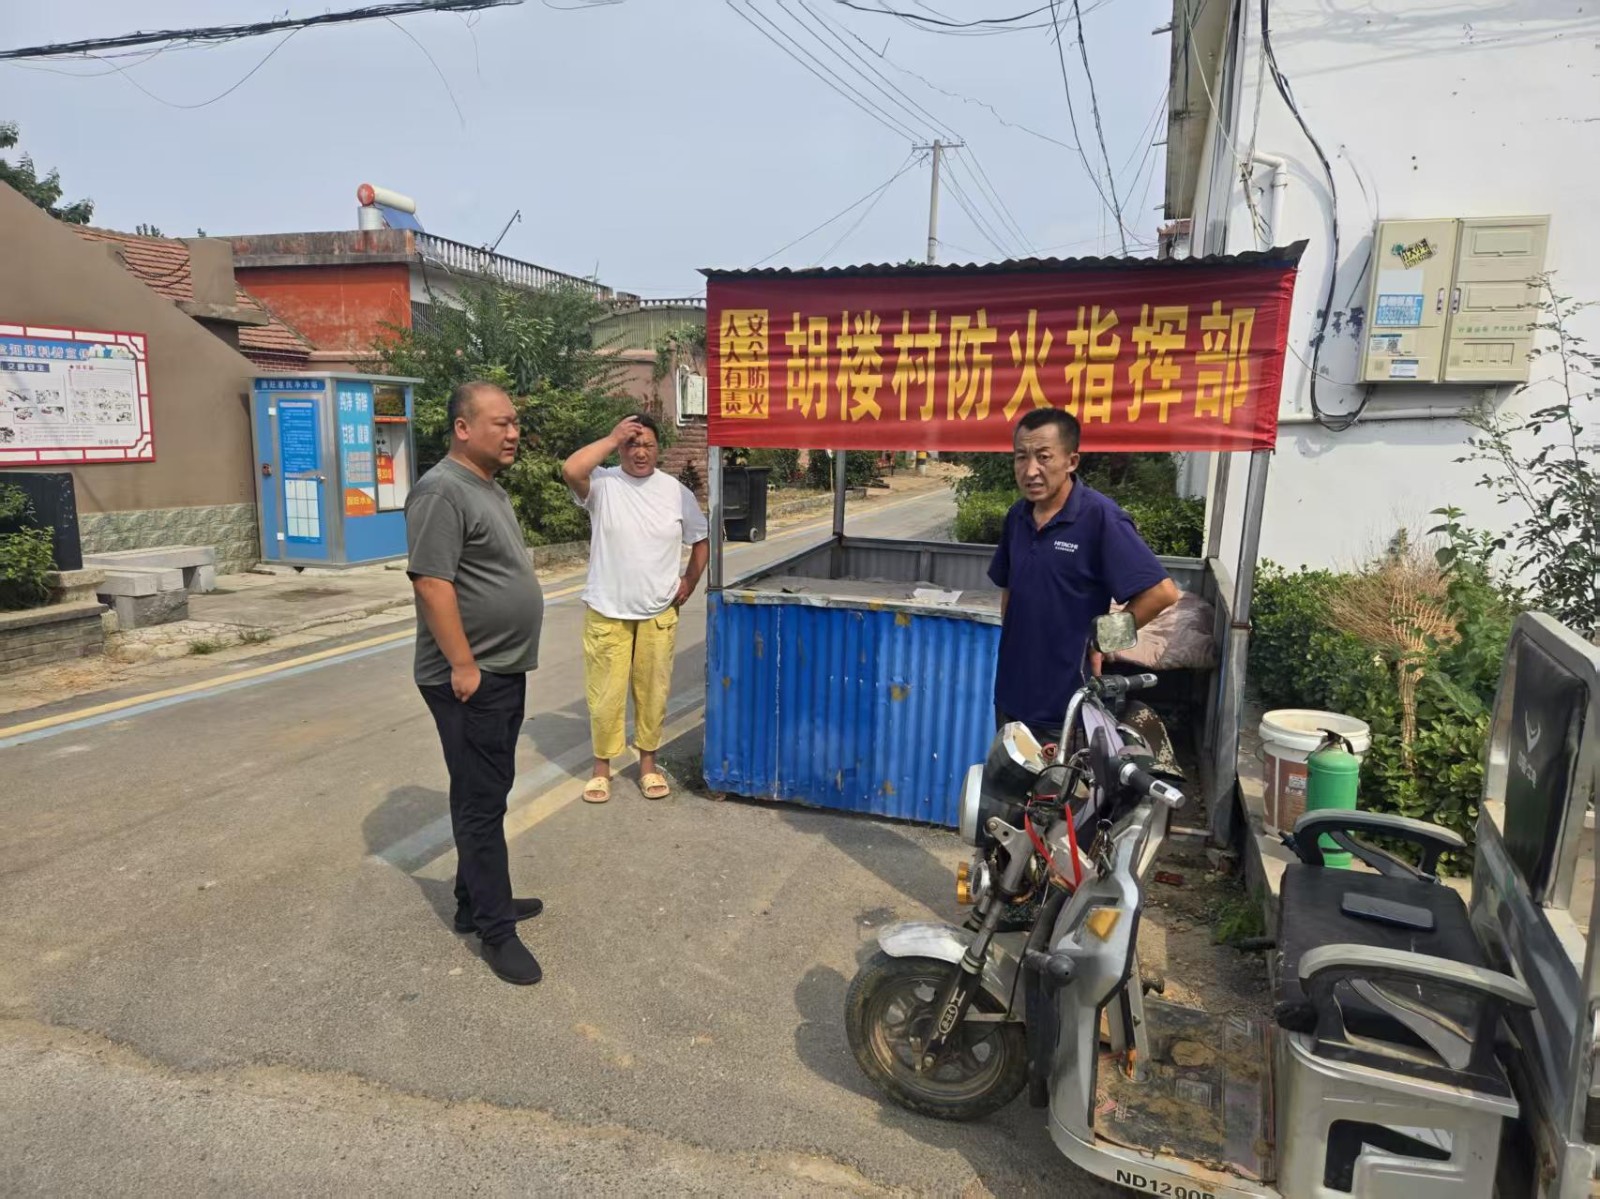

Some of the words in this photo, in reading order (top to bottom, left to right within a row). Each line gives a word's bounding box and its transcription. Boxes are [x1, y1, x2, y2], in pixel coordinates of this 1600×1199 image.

[723, 314, 742, 414] 人人有责
[747, 313, 765, 414] 安全防火
[785, 301, 1256, 425] 胡楼村防火指挥部
[1053, 540, 1079, 550] HITACHI
